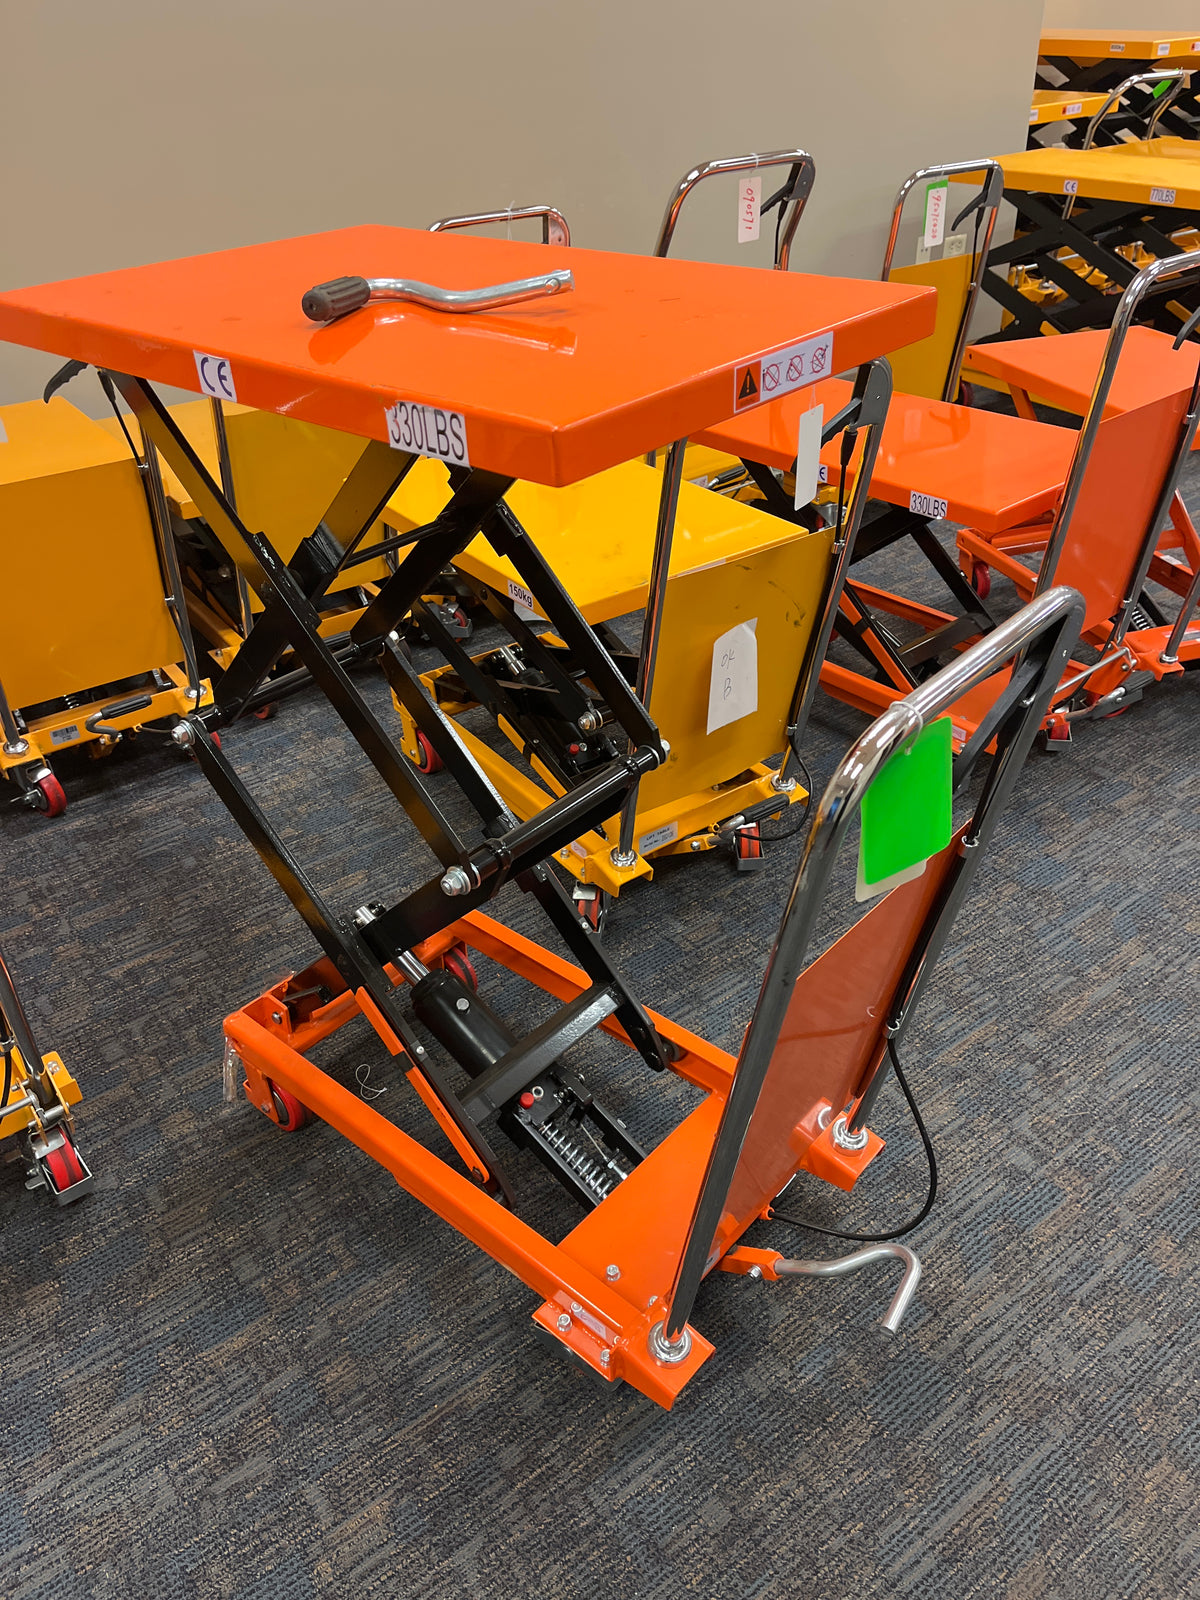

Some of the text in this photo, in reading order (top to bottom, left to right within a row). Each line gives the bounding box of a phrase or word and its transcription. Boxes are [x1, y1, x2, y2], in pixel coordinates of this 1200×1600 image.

[742, 187, 756, 230] 090571
[1151, 188, 1175, 203] 770LBS
[201, 357, 233, 398] CE
[391, 402, 465, 461] 330LBS
[911, 493, 947, 518] 330LBS
[509, 584, 532, 608] 150kg
